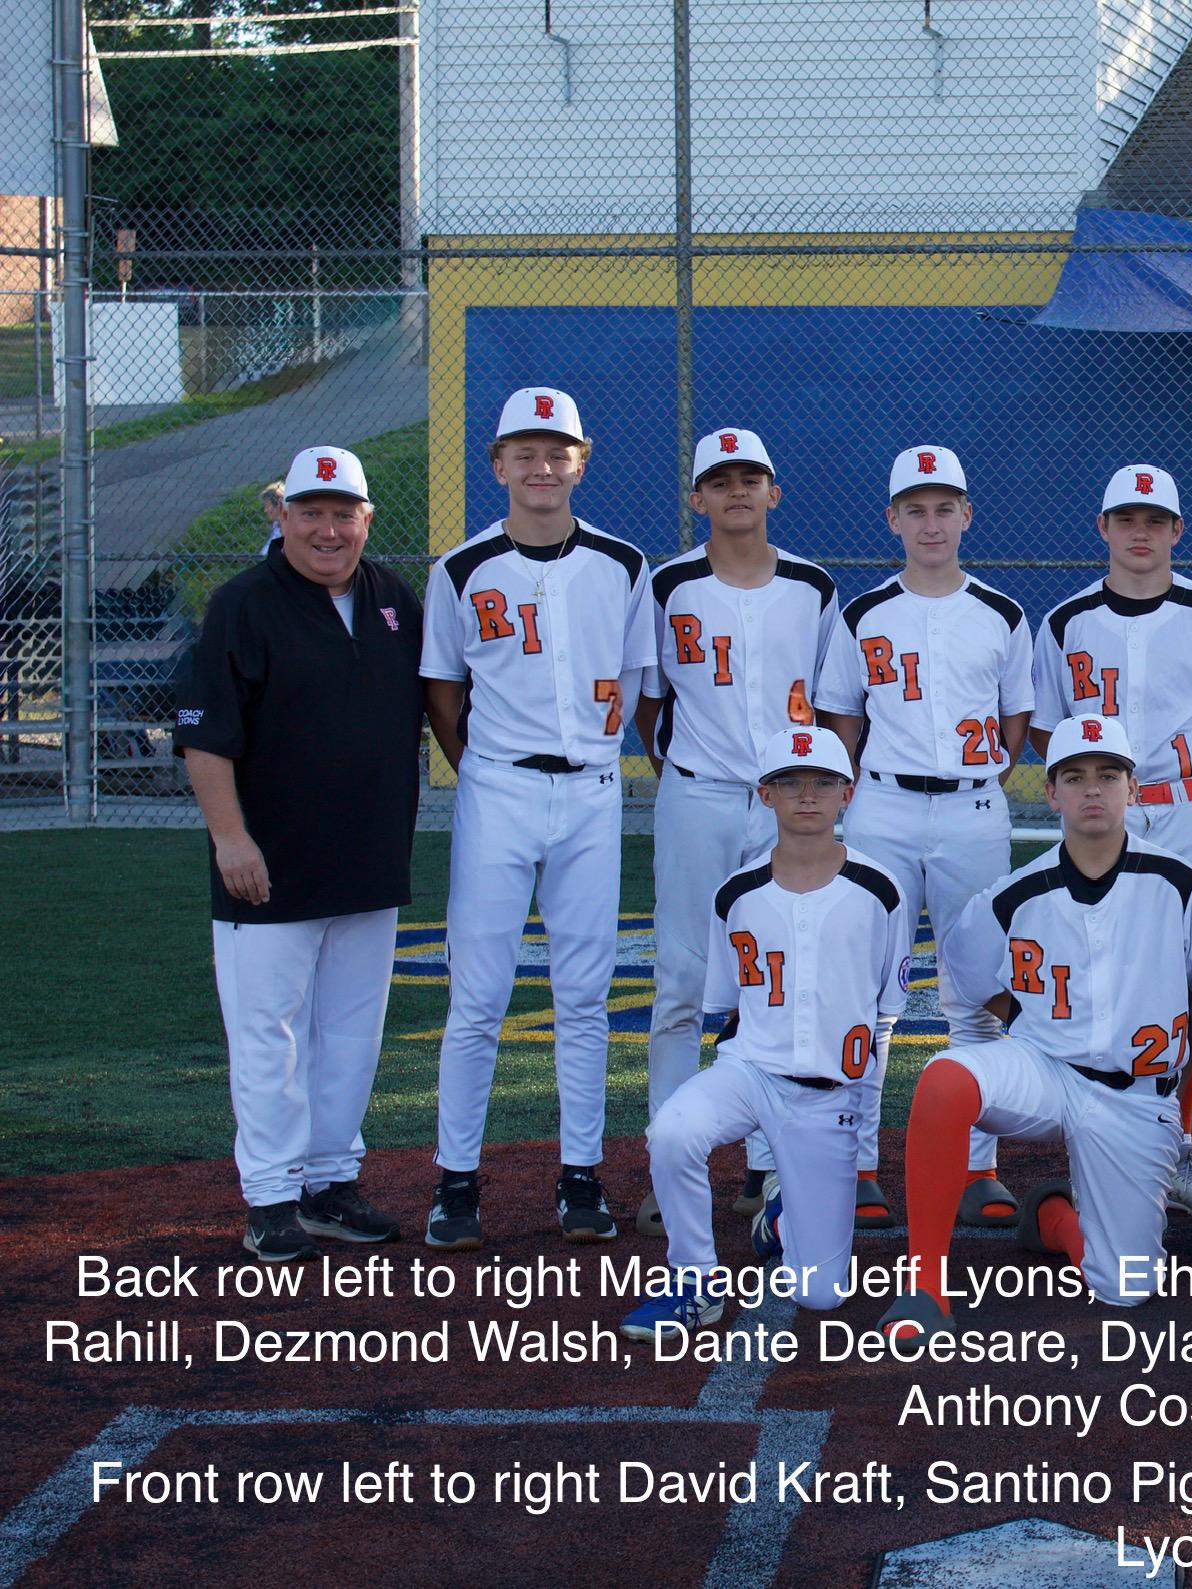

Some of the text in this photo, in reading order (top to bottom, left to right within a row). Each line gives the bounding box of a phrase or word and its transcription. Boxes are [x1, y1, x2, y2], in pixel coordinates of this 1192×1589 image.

[471, 589, 542, 655] RI
[670, 614, 733, 686] RI
[860, 635, 922, 701] RI
[1067, 651, 1118, 716] RI
[178, 709, 204, 717] COACH
[178, 717, 200, 726] LYONS
[594, 680, 623, 735] 7
[956, 715, 1003, 765] 20
[730, 931, 784, 1007] RI
[1009, 938, 1071, 1020] RI
[841, 1024, 871, 1080] 0
[1131, 1013, 1189, 1077] 27
